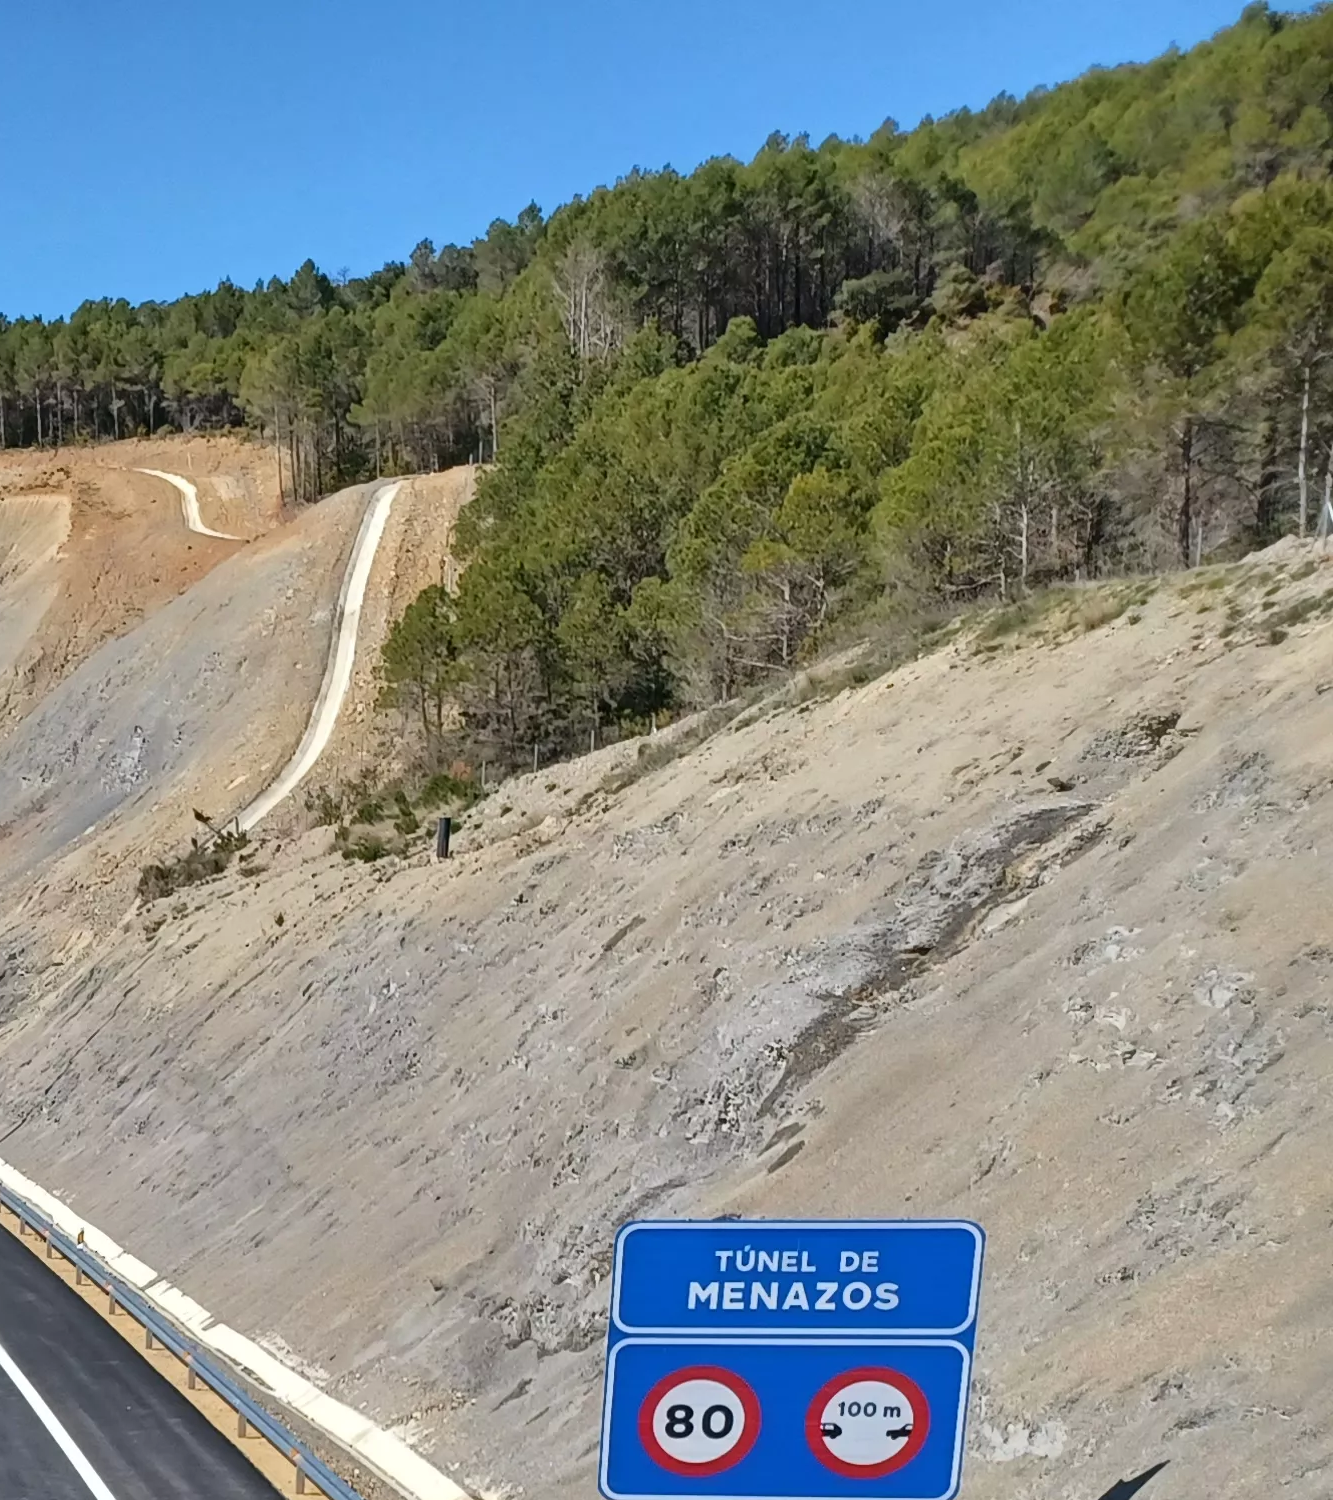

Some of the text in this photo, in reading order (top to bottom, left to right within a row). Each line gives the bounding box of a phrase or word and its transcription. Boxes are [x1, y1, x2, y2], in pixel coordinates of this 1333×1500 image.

[715, 1245, 880, 1273] TÚNEL DE
[687, 1281, 900, 1311] MENAZOS
[664, 1404, 734, 1440] 80
[838, 1402, 901, 1418] 100 m
